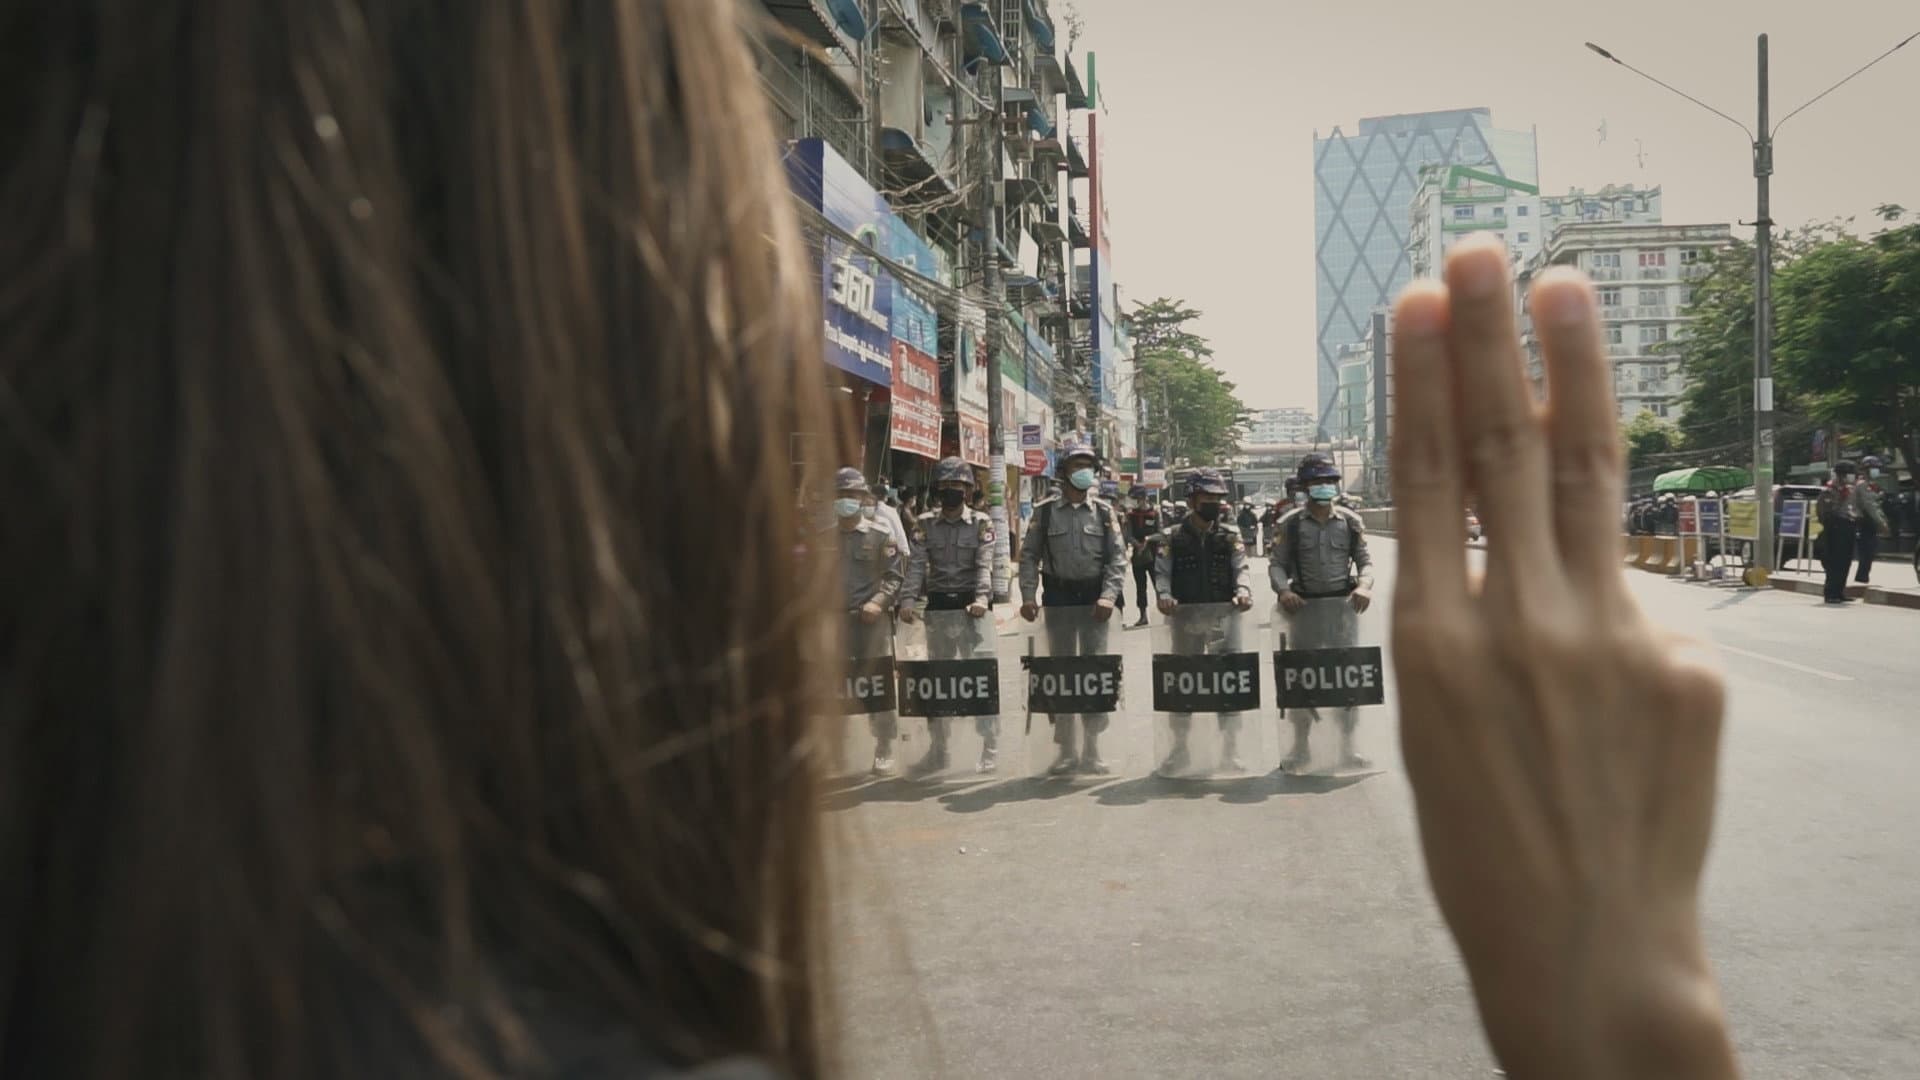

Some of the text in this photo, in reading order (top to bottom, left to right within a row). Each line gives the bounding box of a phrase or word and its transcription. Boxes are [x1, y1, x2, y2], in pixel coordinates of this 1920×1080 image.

[906, 676, 989, 700] POLICE
[1030, 672, 1114, 696] POLICE
[1163, 671, 1251, 695] POLICE
[1284, 664, 1375, 690] POLICE
